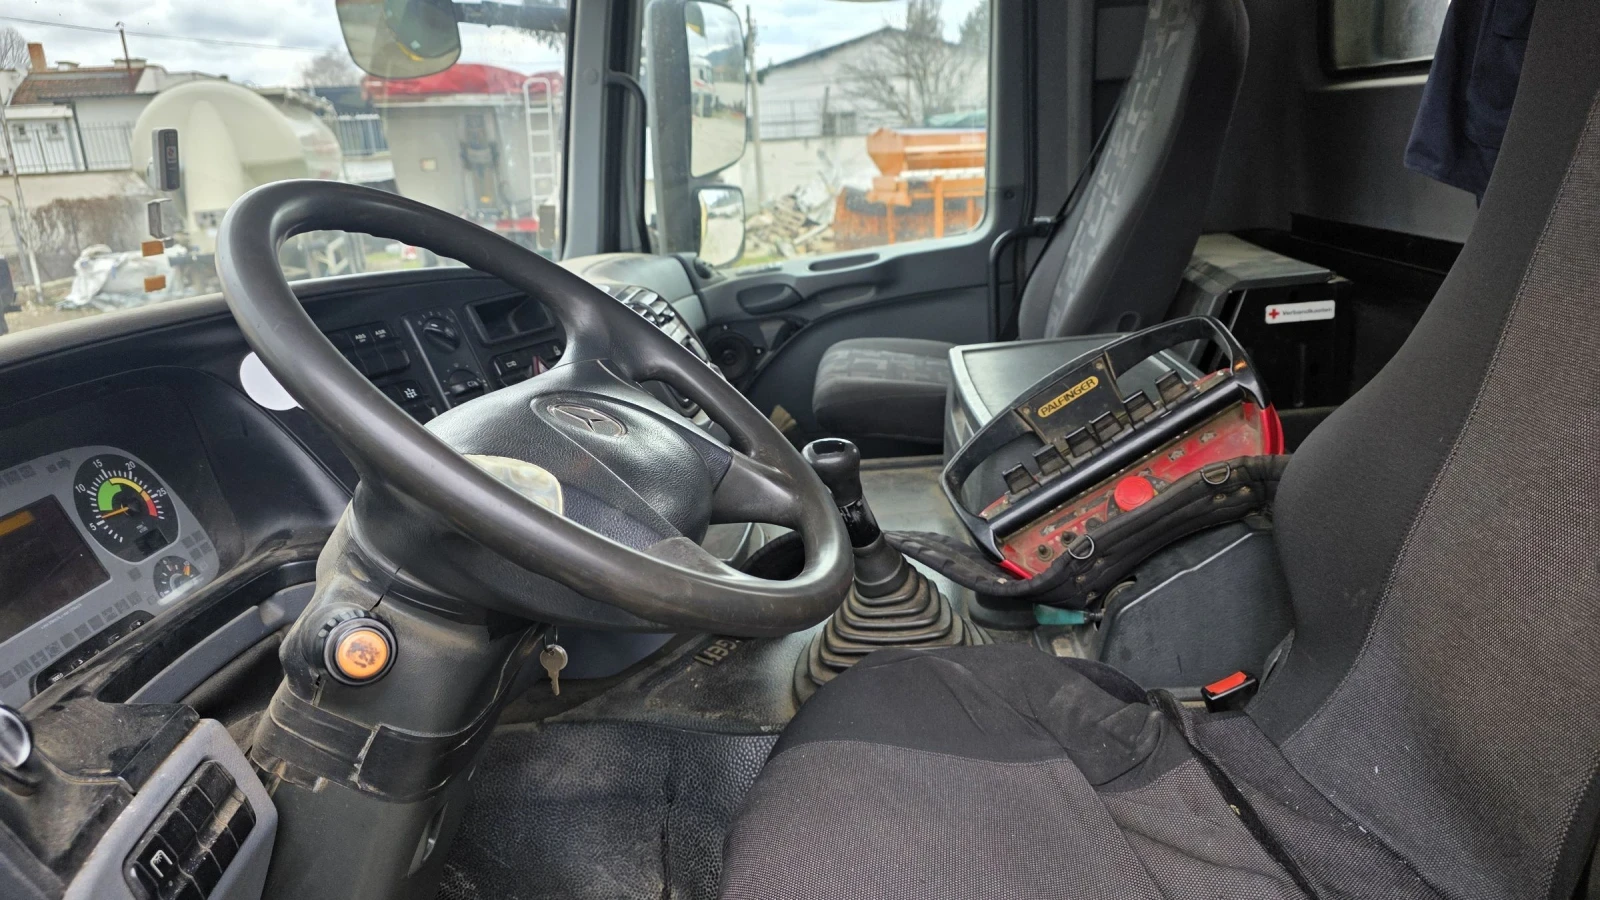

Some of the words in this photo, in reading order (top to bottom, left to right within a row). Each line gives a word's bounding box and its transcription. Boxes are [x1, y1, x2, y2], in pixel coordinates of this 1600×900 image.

[1040, 378, 1096, 416] PALFINGER
[93, 459, 103, 468] 15
[125, 461, 136, 470] 20
[75, 484, 86, 493] 10
[157, 488, 166, 496] 25
[89, 522, 97, 531] 5
